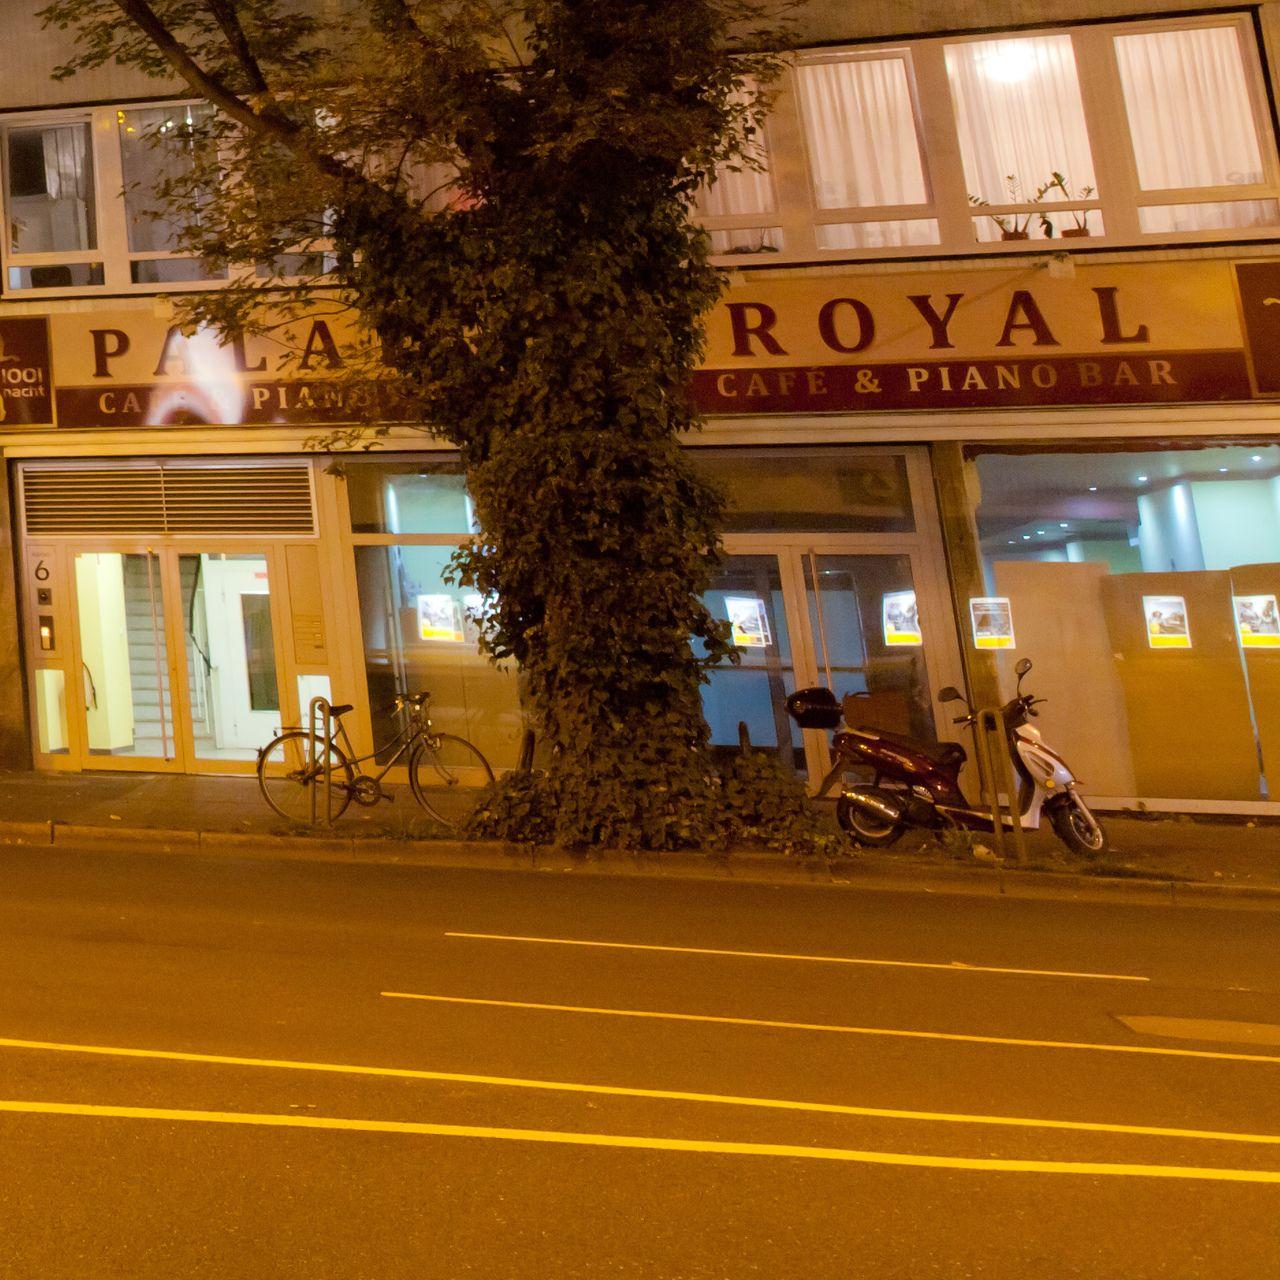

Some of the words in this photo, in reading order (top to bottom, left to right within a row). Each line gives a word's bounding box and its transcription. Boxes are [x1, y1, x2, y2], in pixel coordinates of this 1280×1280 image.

[725, 286, 1151, 358] ROYAL
[2, 367, 43, 384] 1001
[717, 366, 828, 398] CAFÉ
[854, 369, 883, 394] &
[907, 362, 1059, 392] PIANO
[1078, 360, 1178, 388] BAR
[2, 385, 46, 398] nacht
[34, 560, 50, 581] 6
